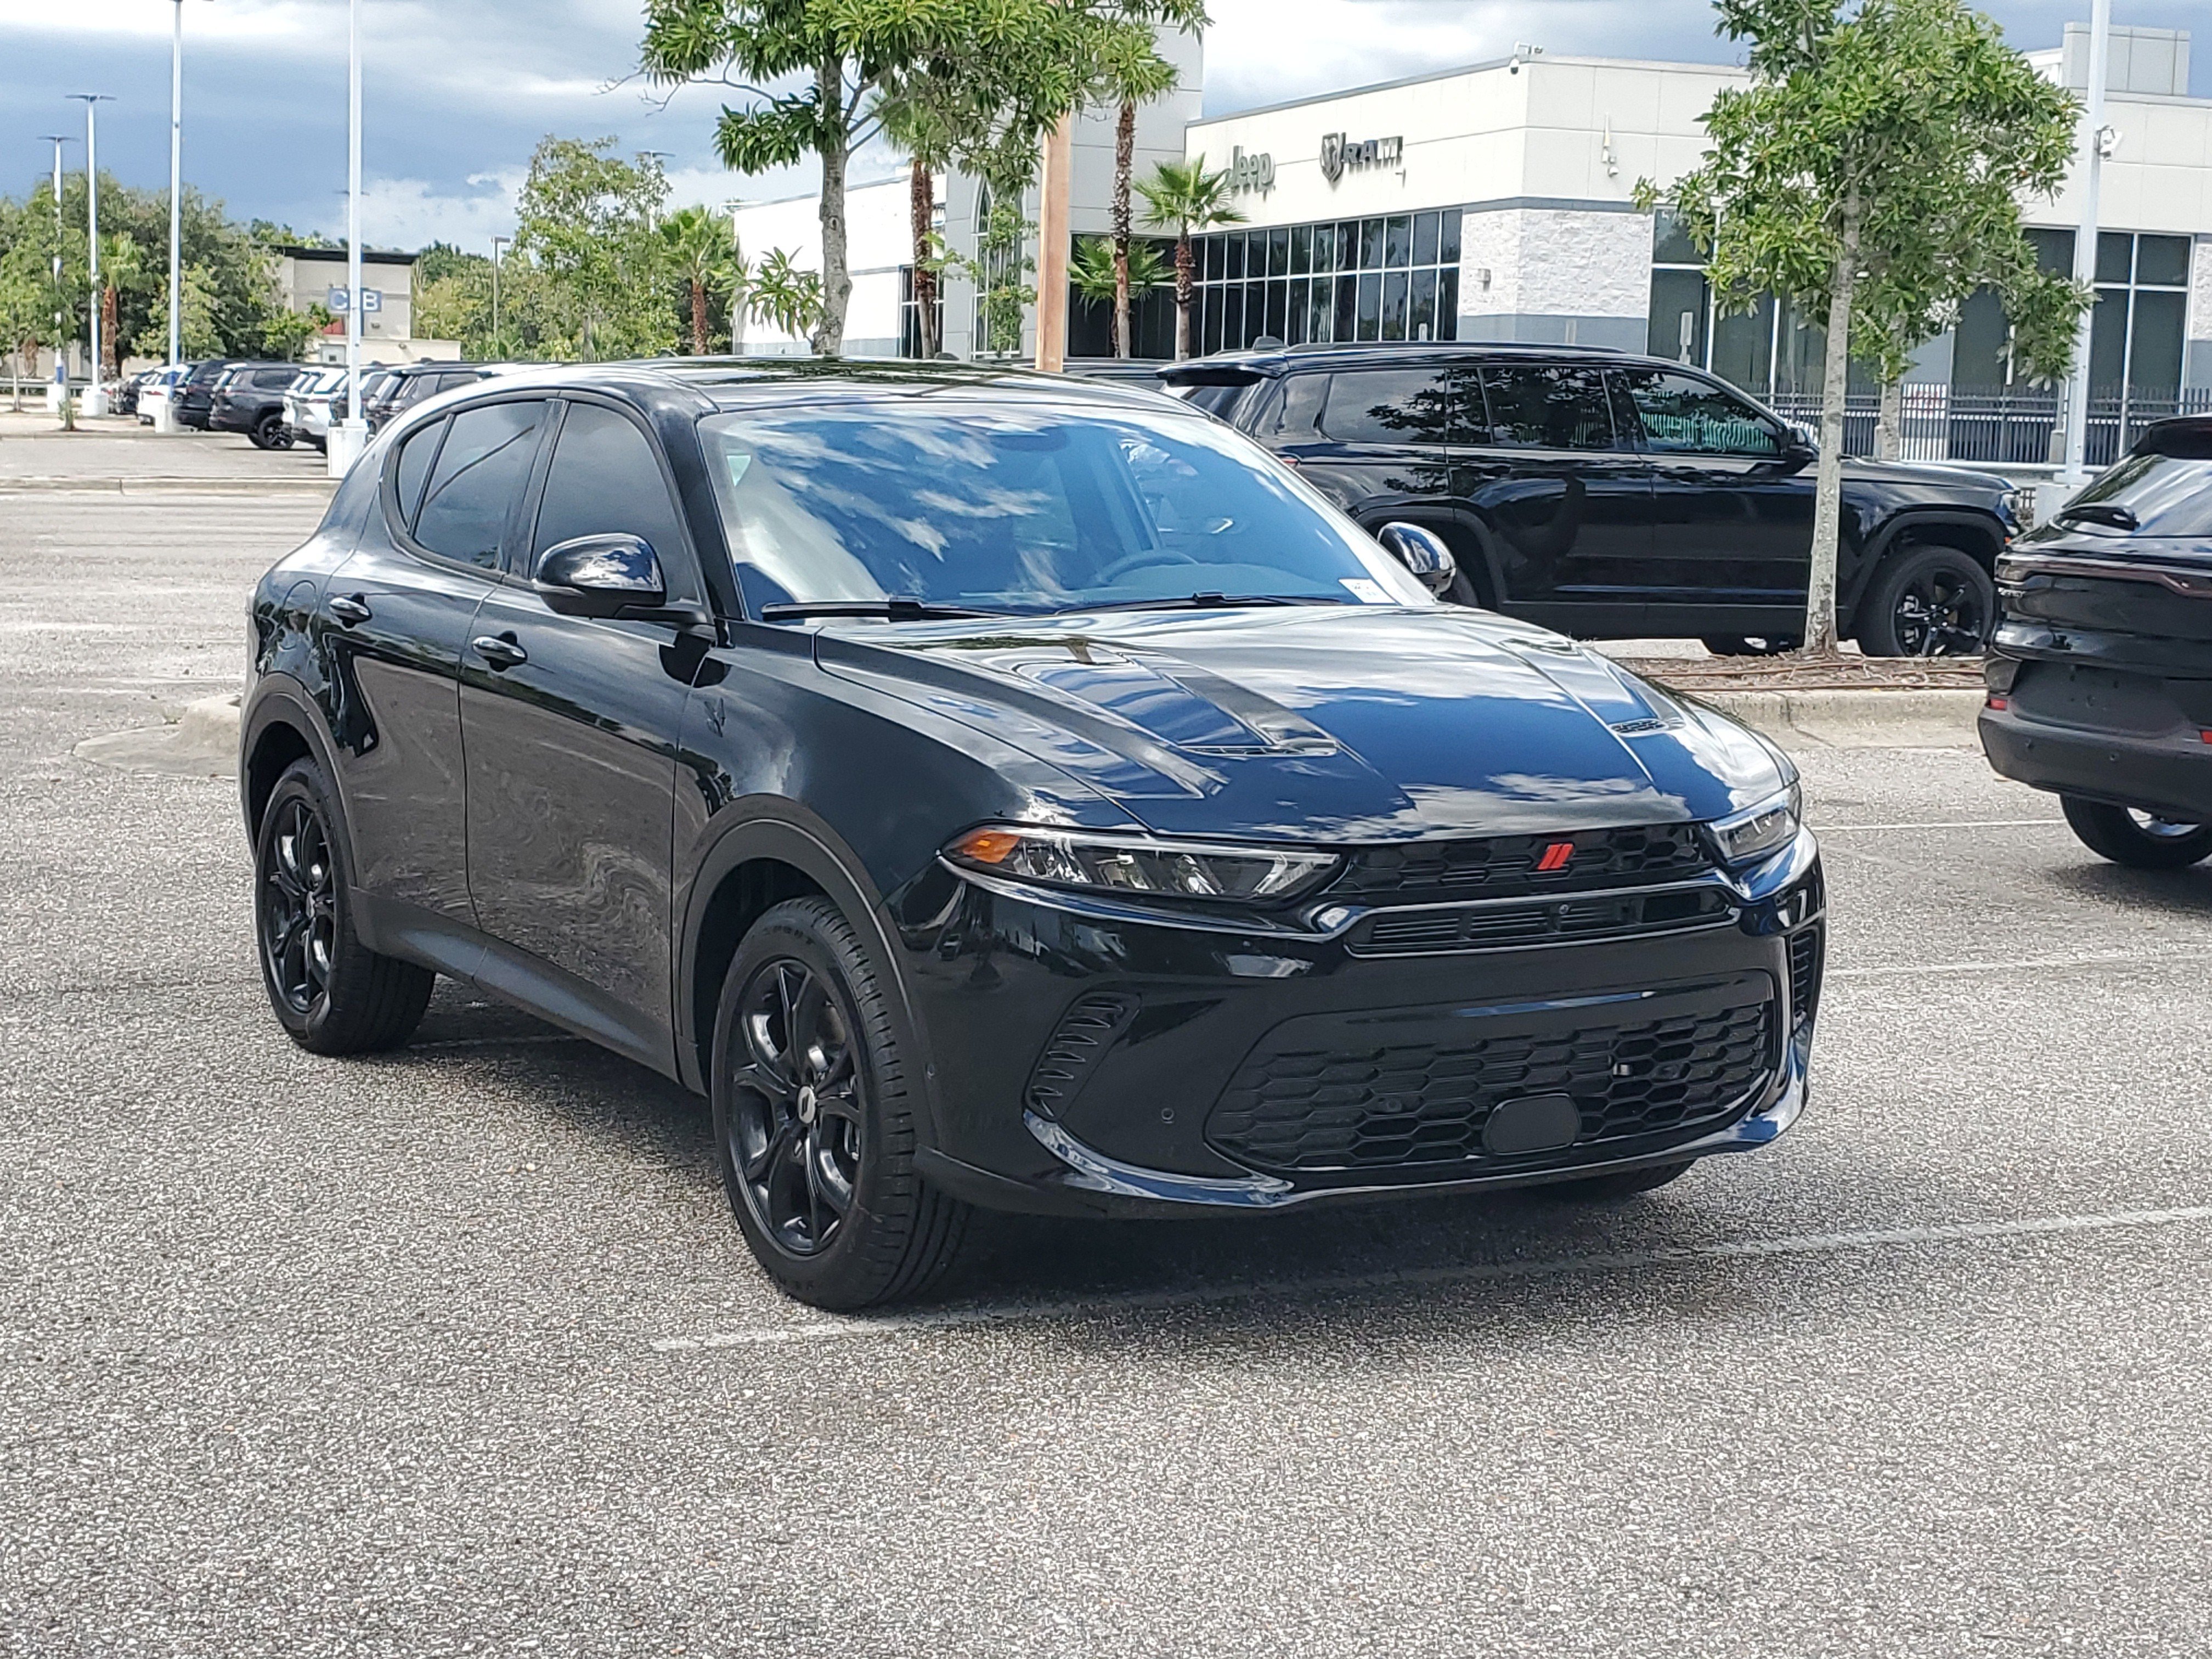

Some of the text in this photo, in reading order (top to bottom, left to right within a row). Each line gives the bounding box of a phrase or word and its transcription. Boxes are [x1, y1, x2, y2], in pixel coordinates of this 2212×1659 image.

[1343, 136, 1403, 166] RAM
[1227, 145, 1274, 197] Jeep
[331, 290, 348, 309] C
[363, 291, 379, 311] B
